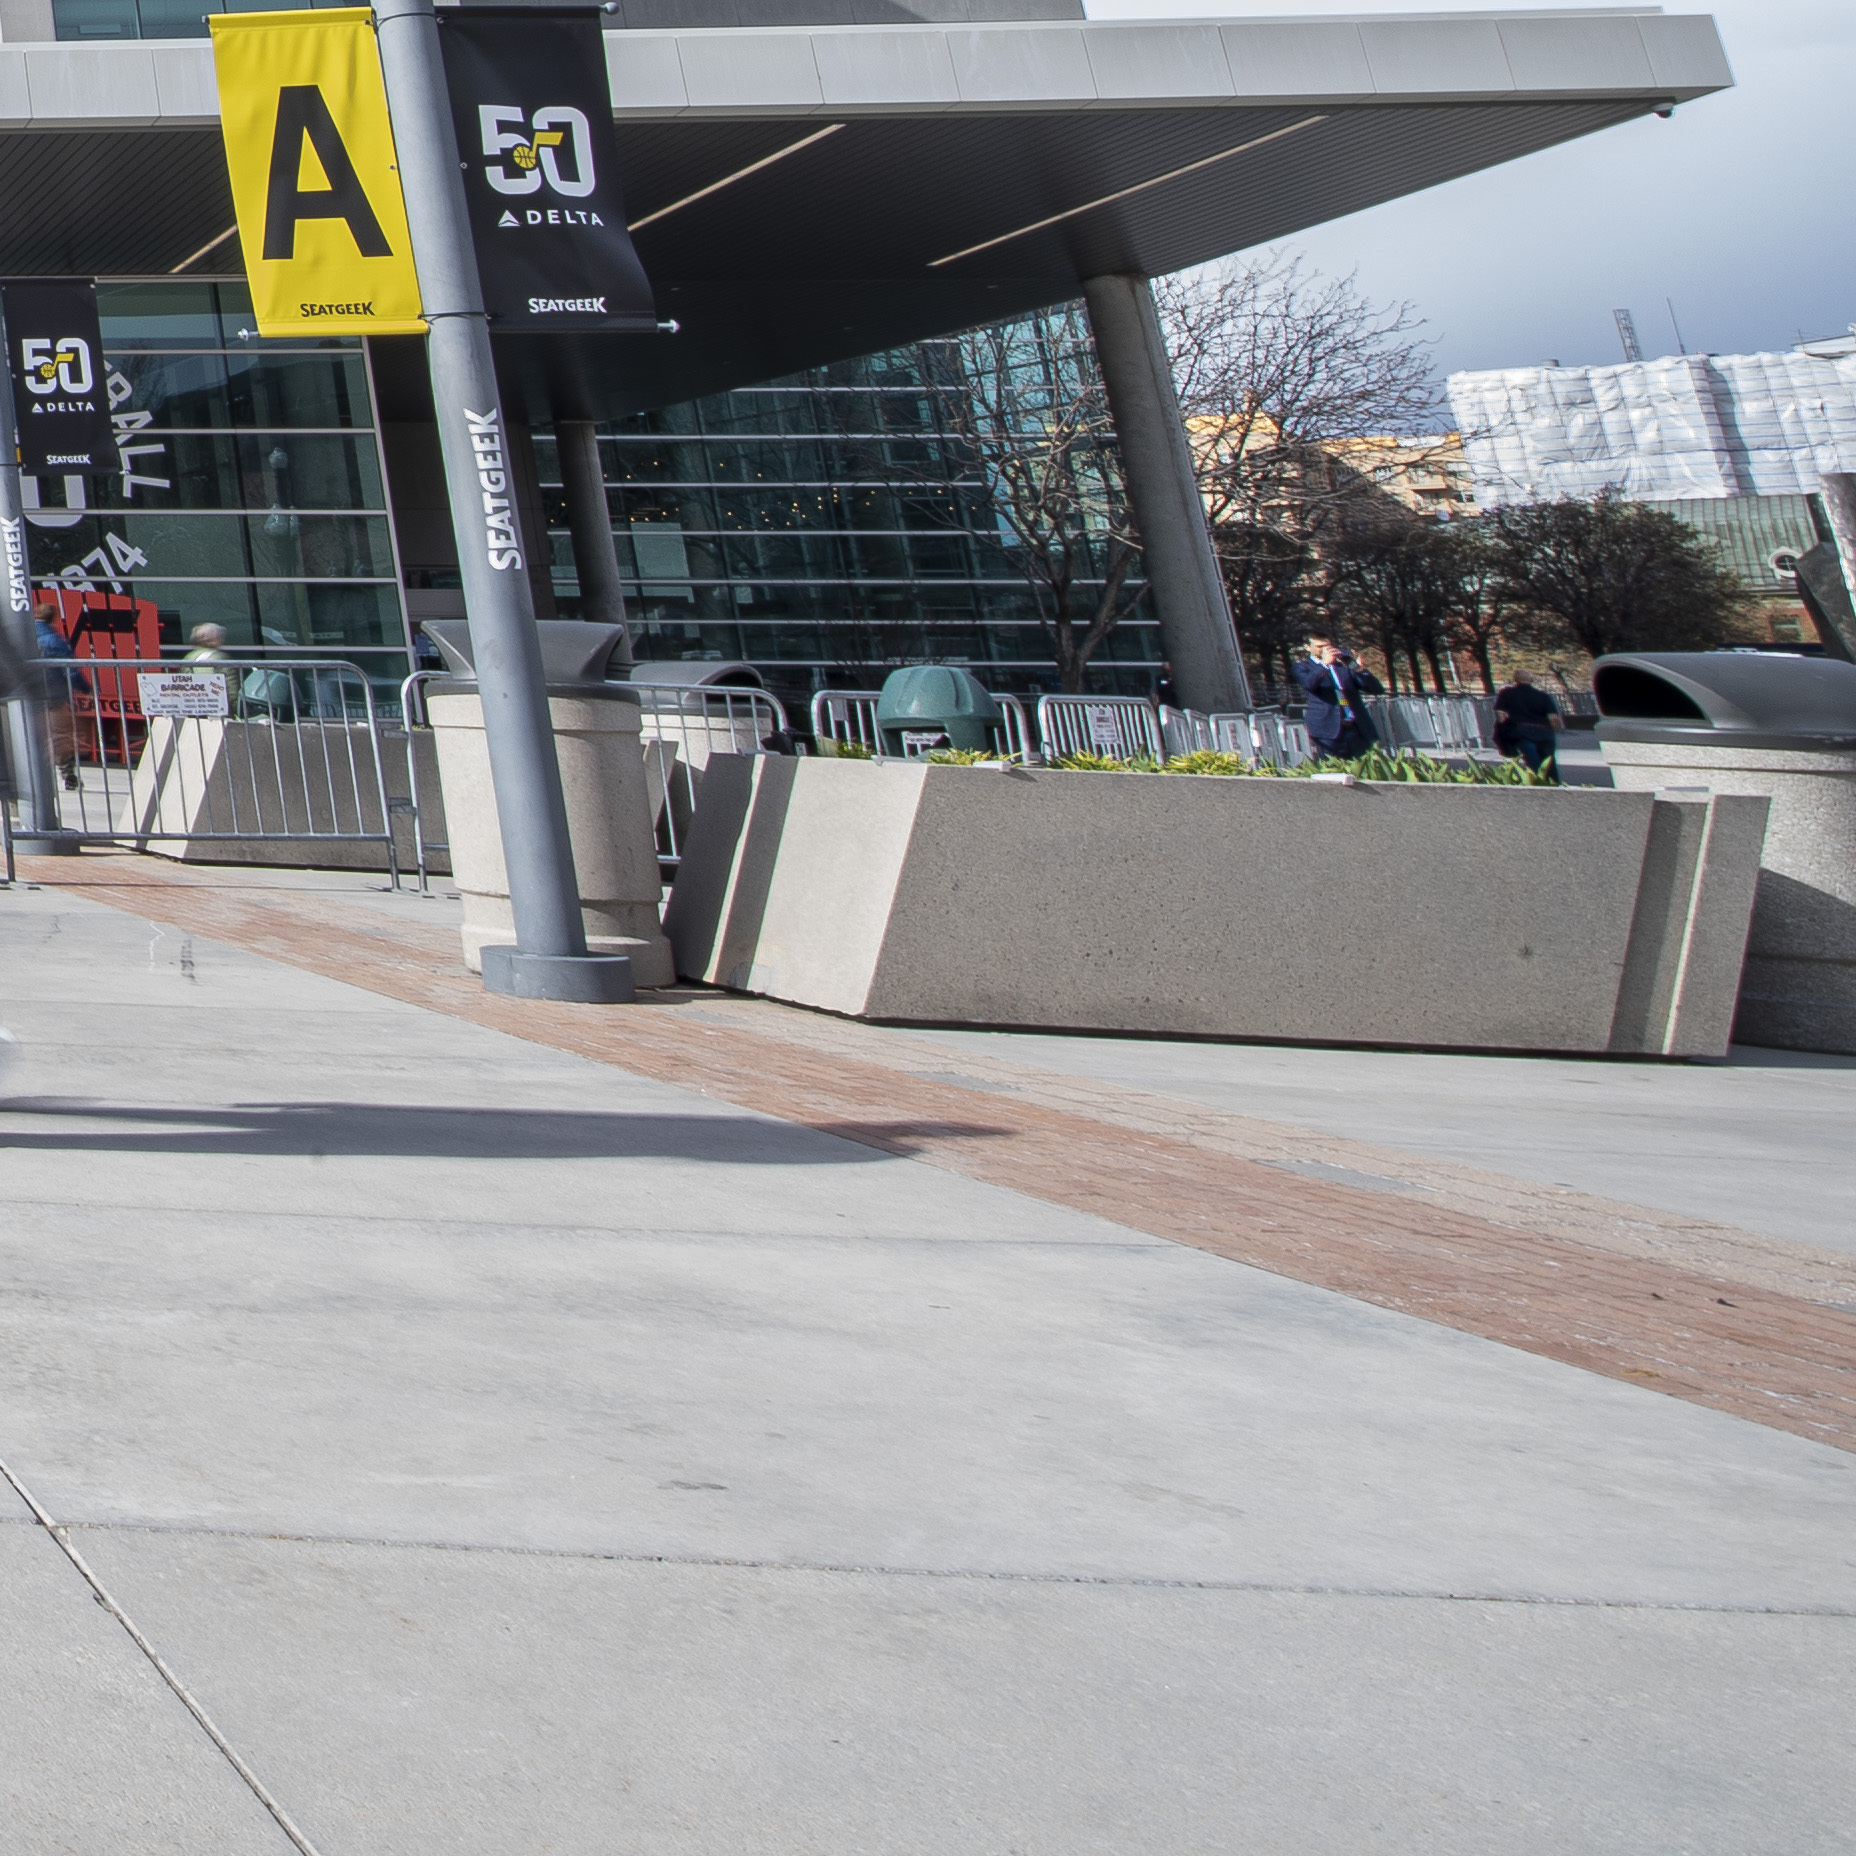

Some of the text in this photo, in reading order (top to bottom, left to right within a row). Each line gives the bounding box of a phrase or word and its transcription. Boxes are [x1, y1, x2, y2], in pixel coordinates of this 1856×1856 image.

[478, 105, 596, 198] 50
[262, 83, 394, 261] A
[526, 209, 604, 227] DELTA
[300, 300, 375, 317] SEATGEEK
[528, 296, 607, 314] SEATGEEK
[21, 337, 93, 394] 50
[47, 401, 95, 412] DELTA
[46, 453, 92, 465] SEATGEEK
[463, 407, 523, 570] SEATGEEK
[0, 516, 30, 613] SEATGEEK
[160, 683, 206, 692] BARRICADE
[171, 674, 193, 683] UTAH
